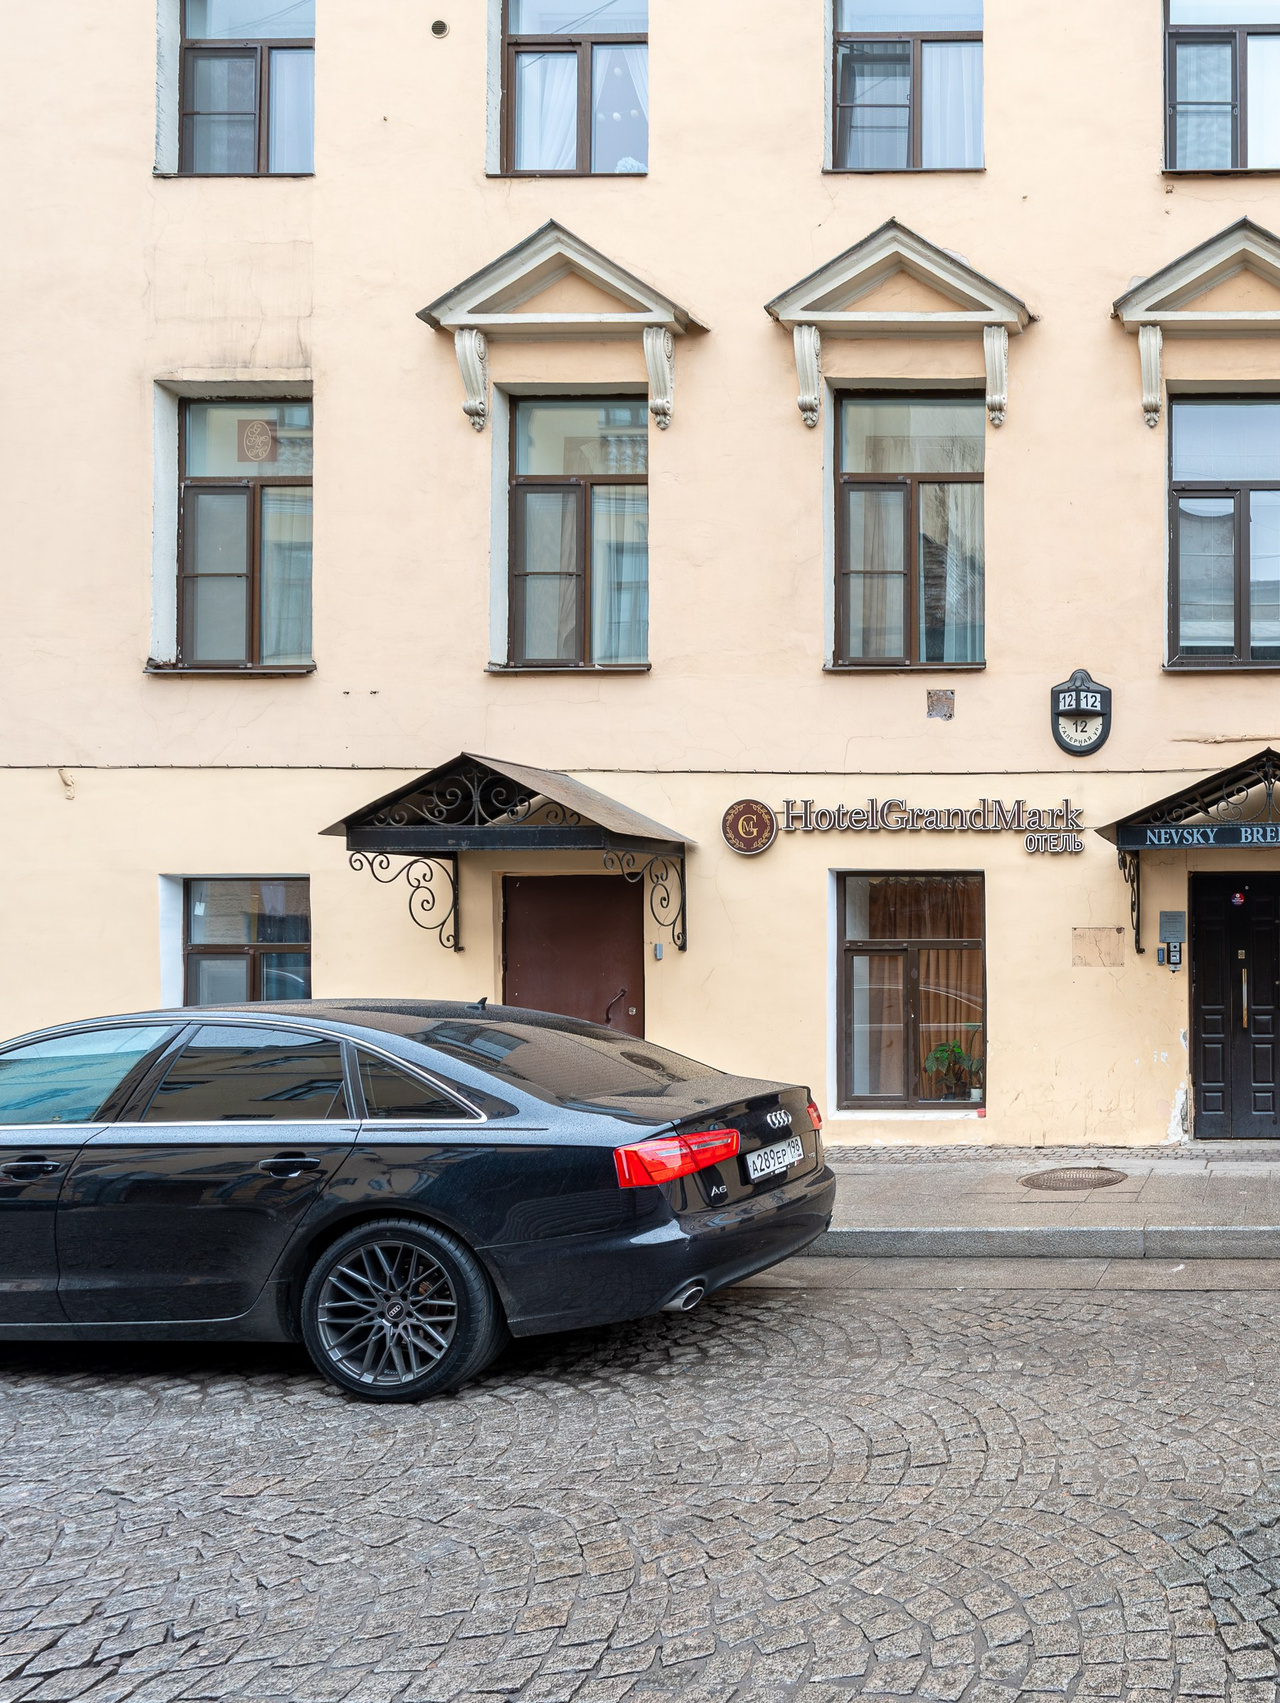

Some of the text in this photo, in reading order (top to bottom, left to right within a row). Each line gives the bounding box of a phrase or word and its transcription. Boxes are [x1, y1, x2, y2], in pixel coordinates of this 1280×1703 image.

[1061, 693, 1074, 708] 12
[1083, 693, 1098, 708] 12
[1072, 720, 1088, 733] 12
[1061, 726, 1093, 745] ГАЛЕРНАЯ
[782, 798, 1084, 831] HotelGrandMark
[1024, 833, 1085, 853] ОТЕЛЬ
[1145, 828, 1218, 845] NEVSKY
[711, 1185, 727, 1197] A6
